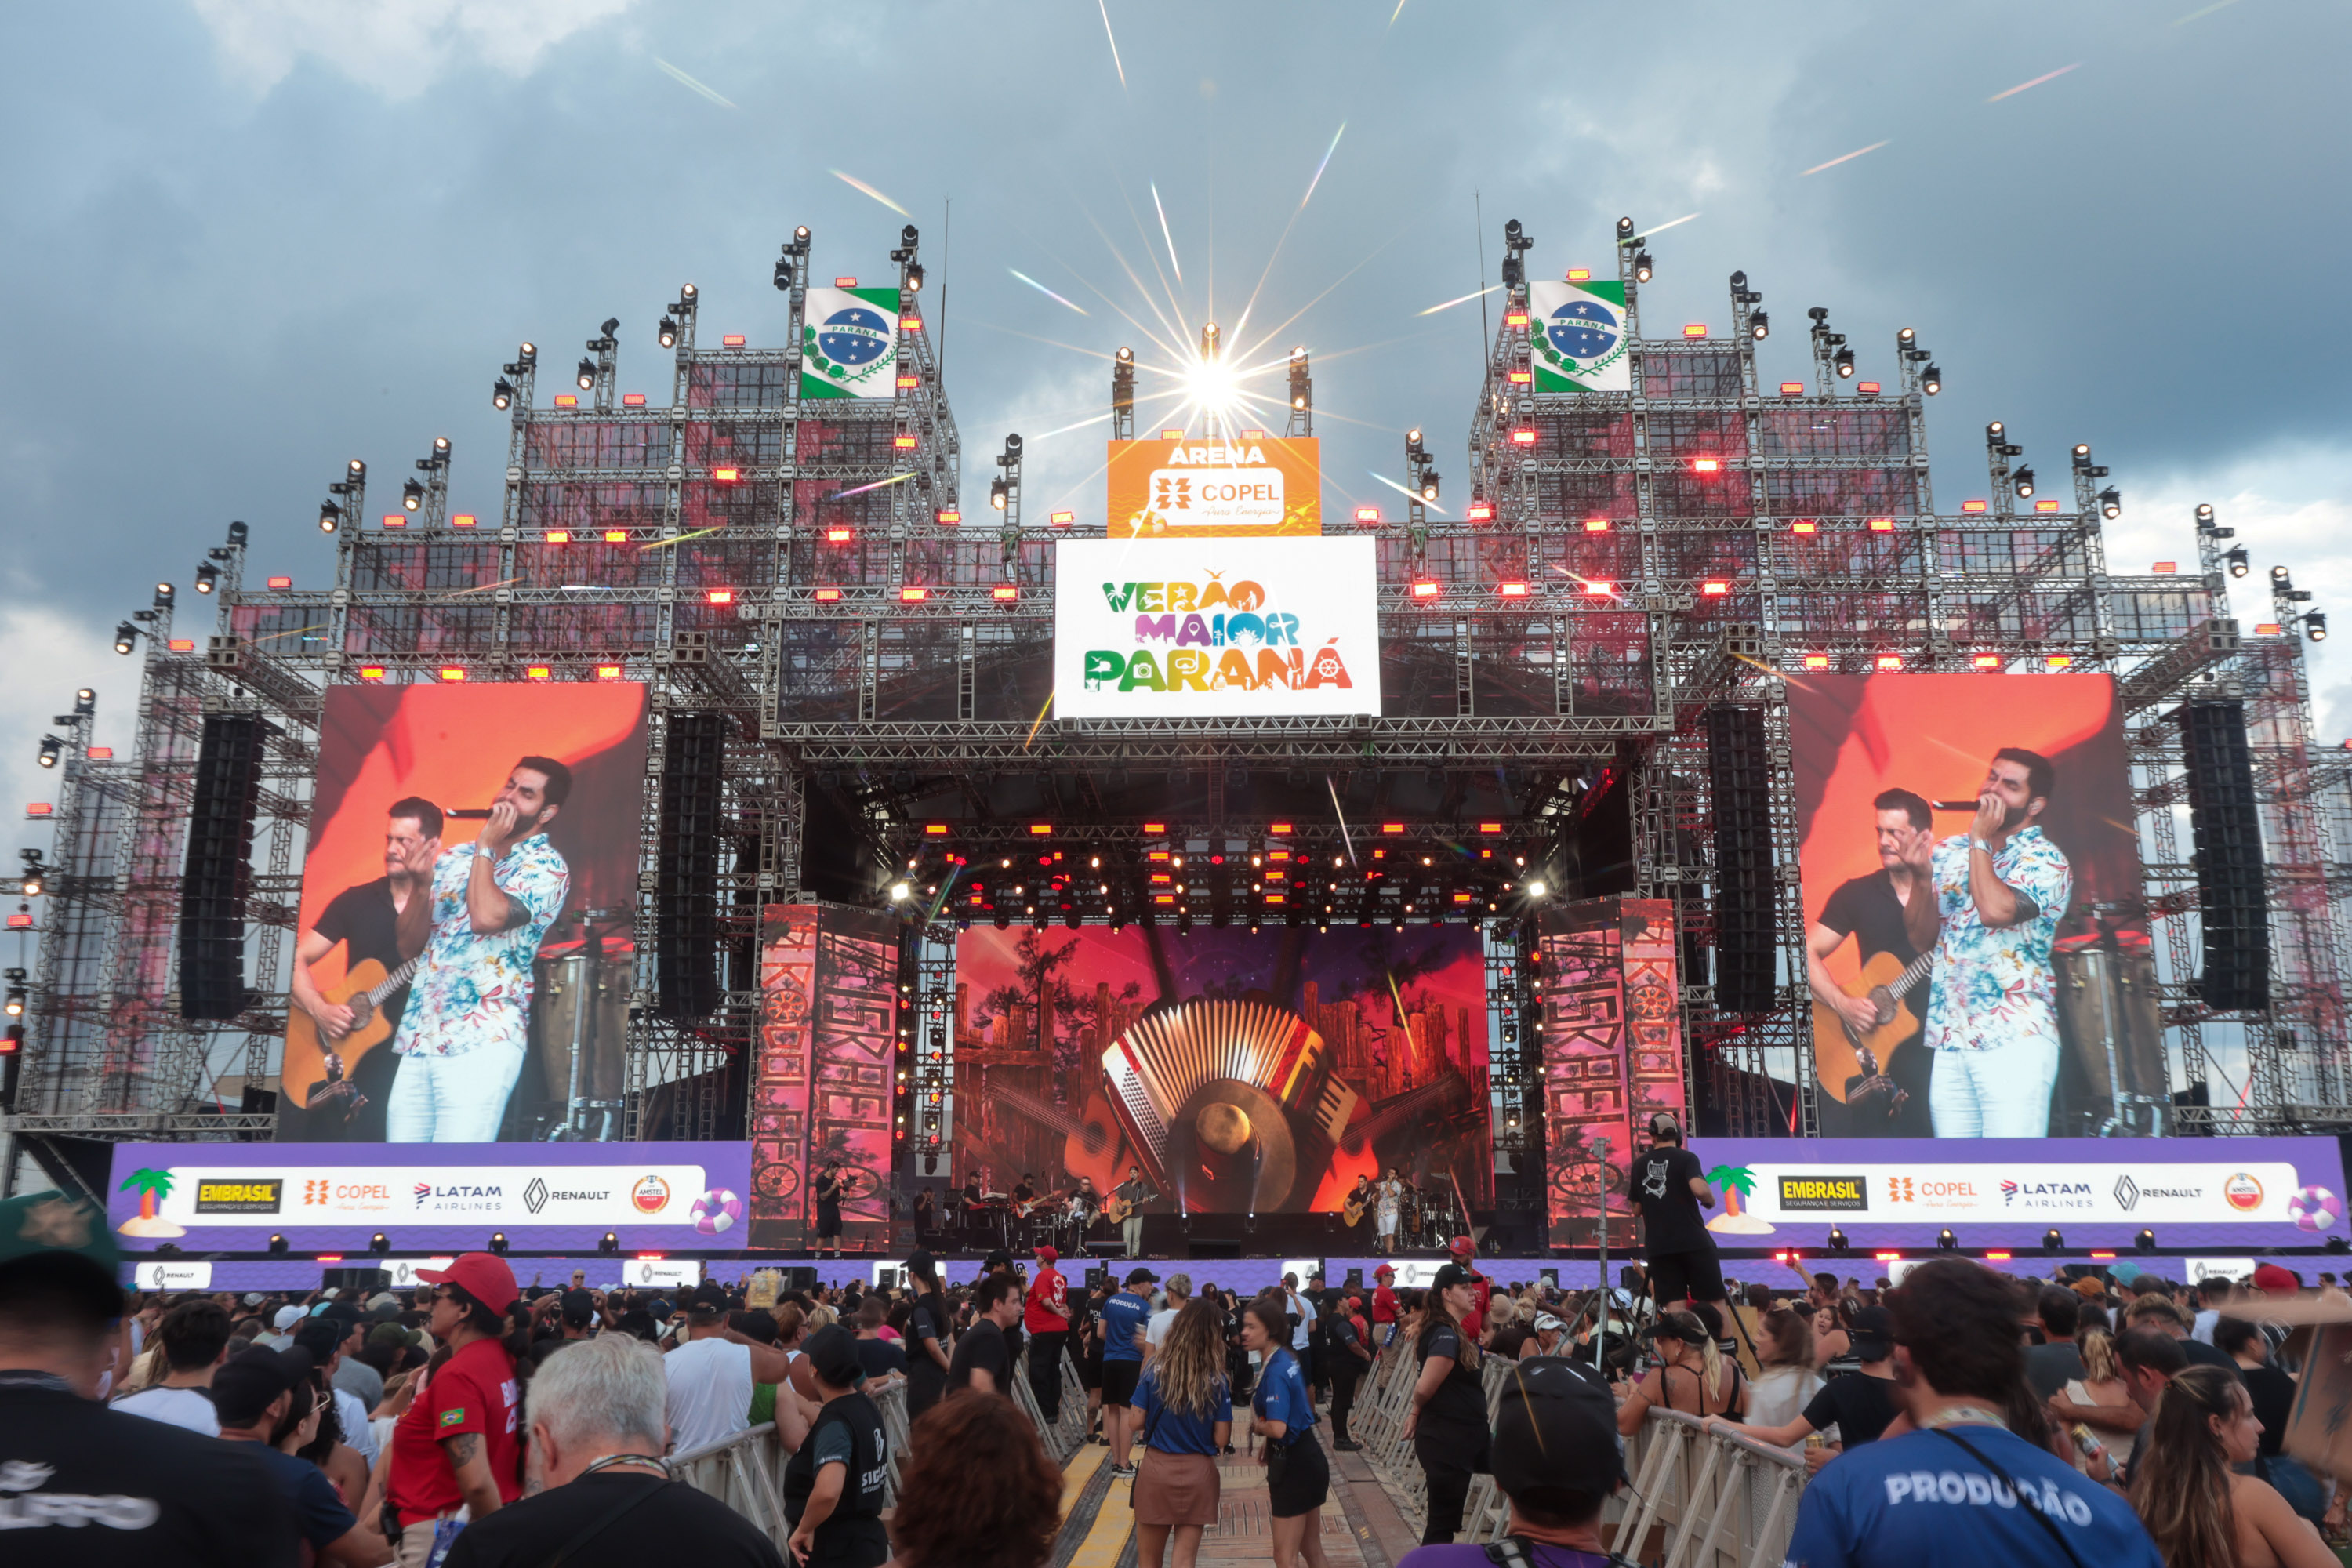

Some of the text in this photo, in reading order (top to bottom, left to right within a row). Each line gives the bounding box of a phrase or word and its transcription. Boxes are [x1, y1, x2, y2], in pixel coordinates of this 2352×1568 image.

[1167, 446, 1267, 465] ARENA
[1202, 484, 1279, 501] COPEL
[1102, 568, 1265, 612] VERÃO
[1135, 612, 1300, 647] MAIOR
[1084, 637, 1353, 692] PARANÁ
[198, 1184, 276, 1202] EMBRASIL
[336, 1185, 390, 1199] COPEL
[436, 1186, 502, 1198] LATAM
[552, 1190, 610, 1200] RENAULT
[1783, 1181, 1860, 1199] EMBRASIL
[1922, 1182, 1978, 1196] COPEL
[2023, 1183, 2092, 1195] LATAM
[2143, 1188, 2203, 1199] RENAULT
[434, 1202, 502, 1210] AIRLINES
[2025, 1200, 2093, 1208] AIRLINES
[1109, 1298, 1141, 1312] PRODUÇÃO
